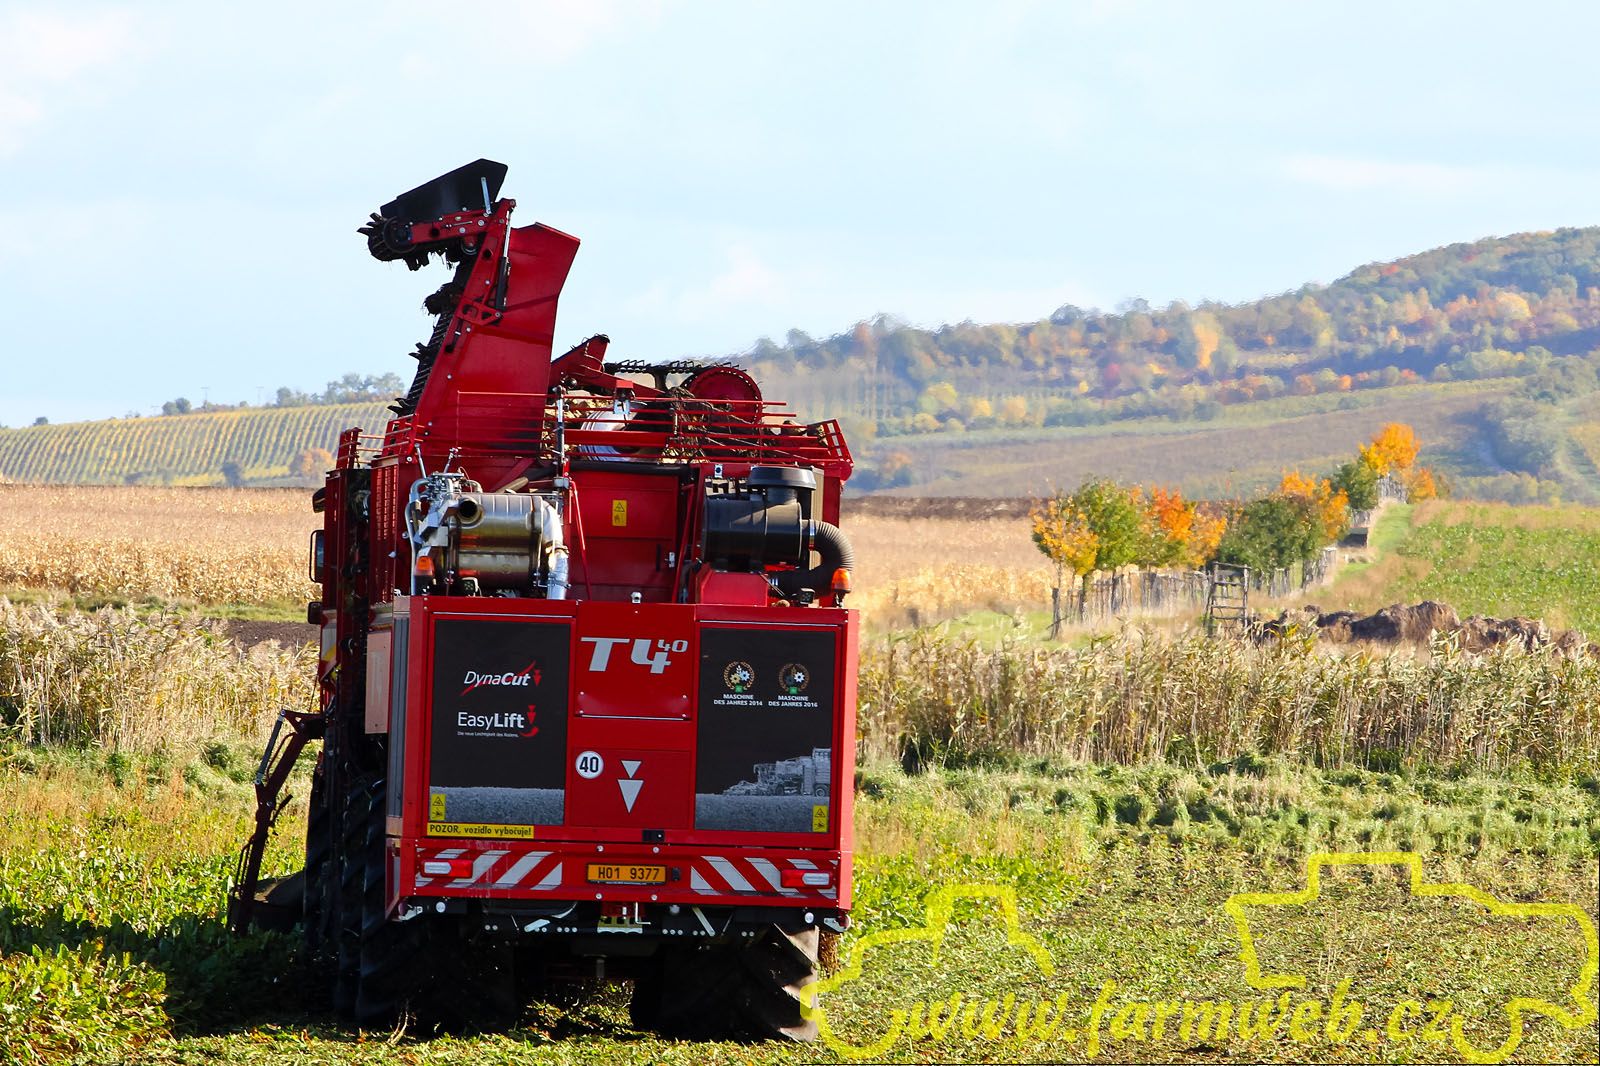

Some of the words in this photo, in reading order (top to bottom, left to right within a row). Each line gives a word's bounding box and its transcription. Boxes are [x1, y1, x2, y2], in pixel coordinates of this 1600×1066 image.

[463, 671, 531, 688] DynaCut
[458, 711, 525, 731] EasyLift
[579, 756, 599, 773] 40
[464, 826, 491, 835] vozidlo
[494, 827, 532, 838] vybočuje!
[598, 867, 621, 879] H01
[630, 868, 660, 881] 9377
